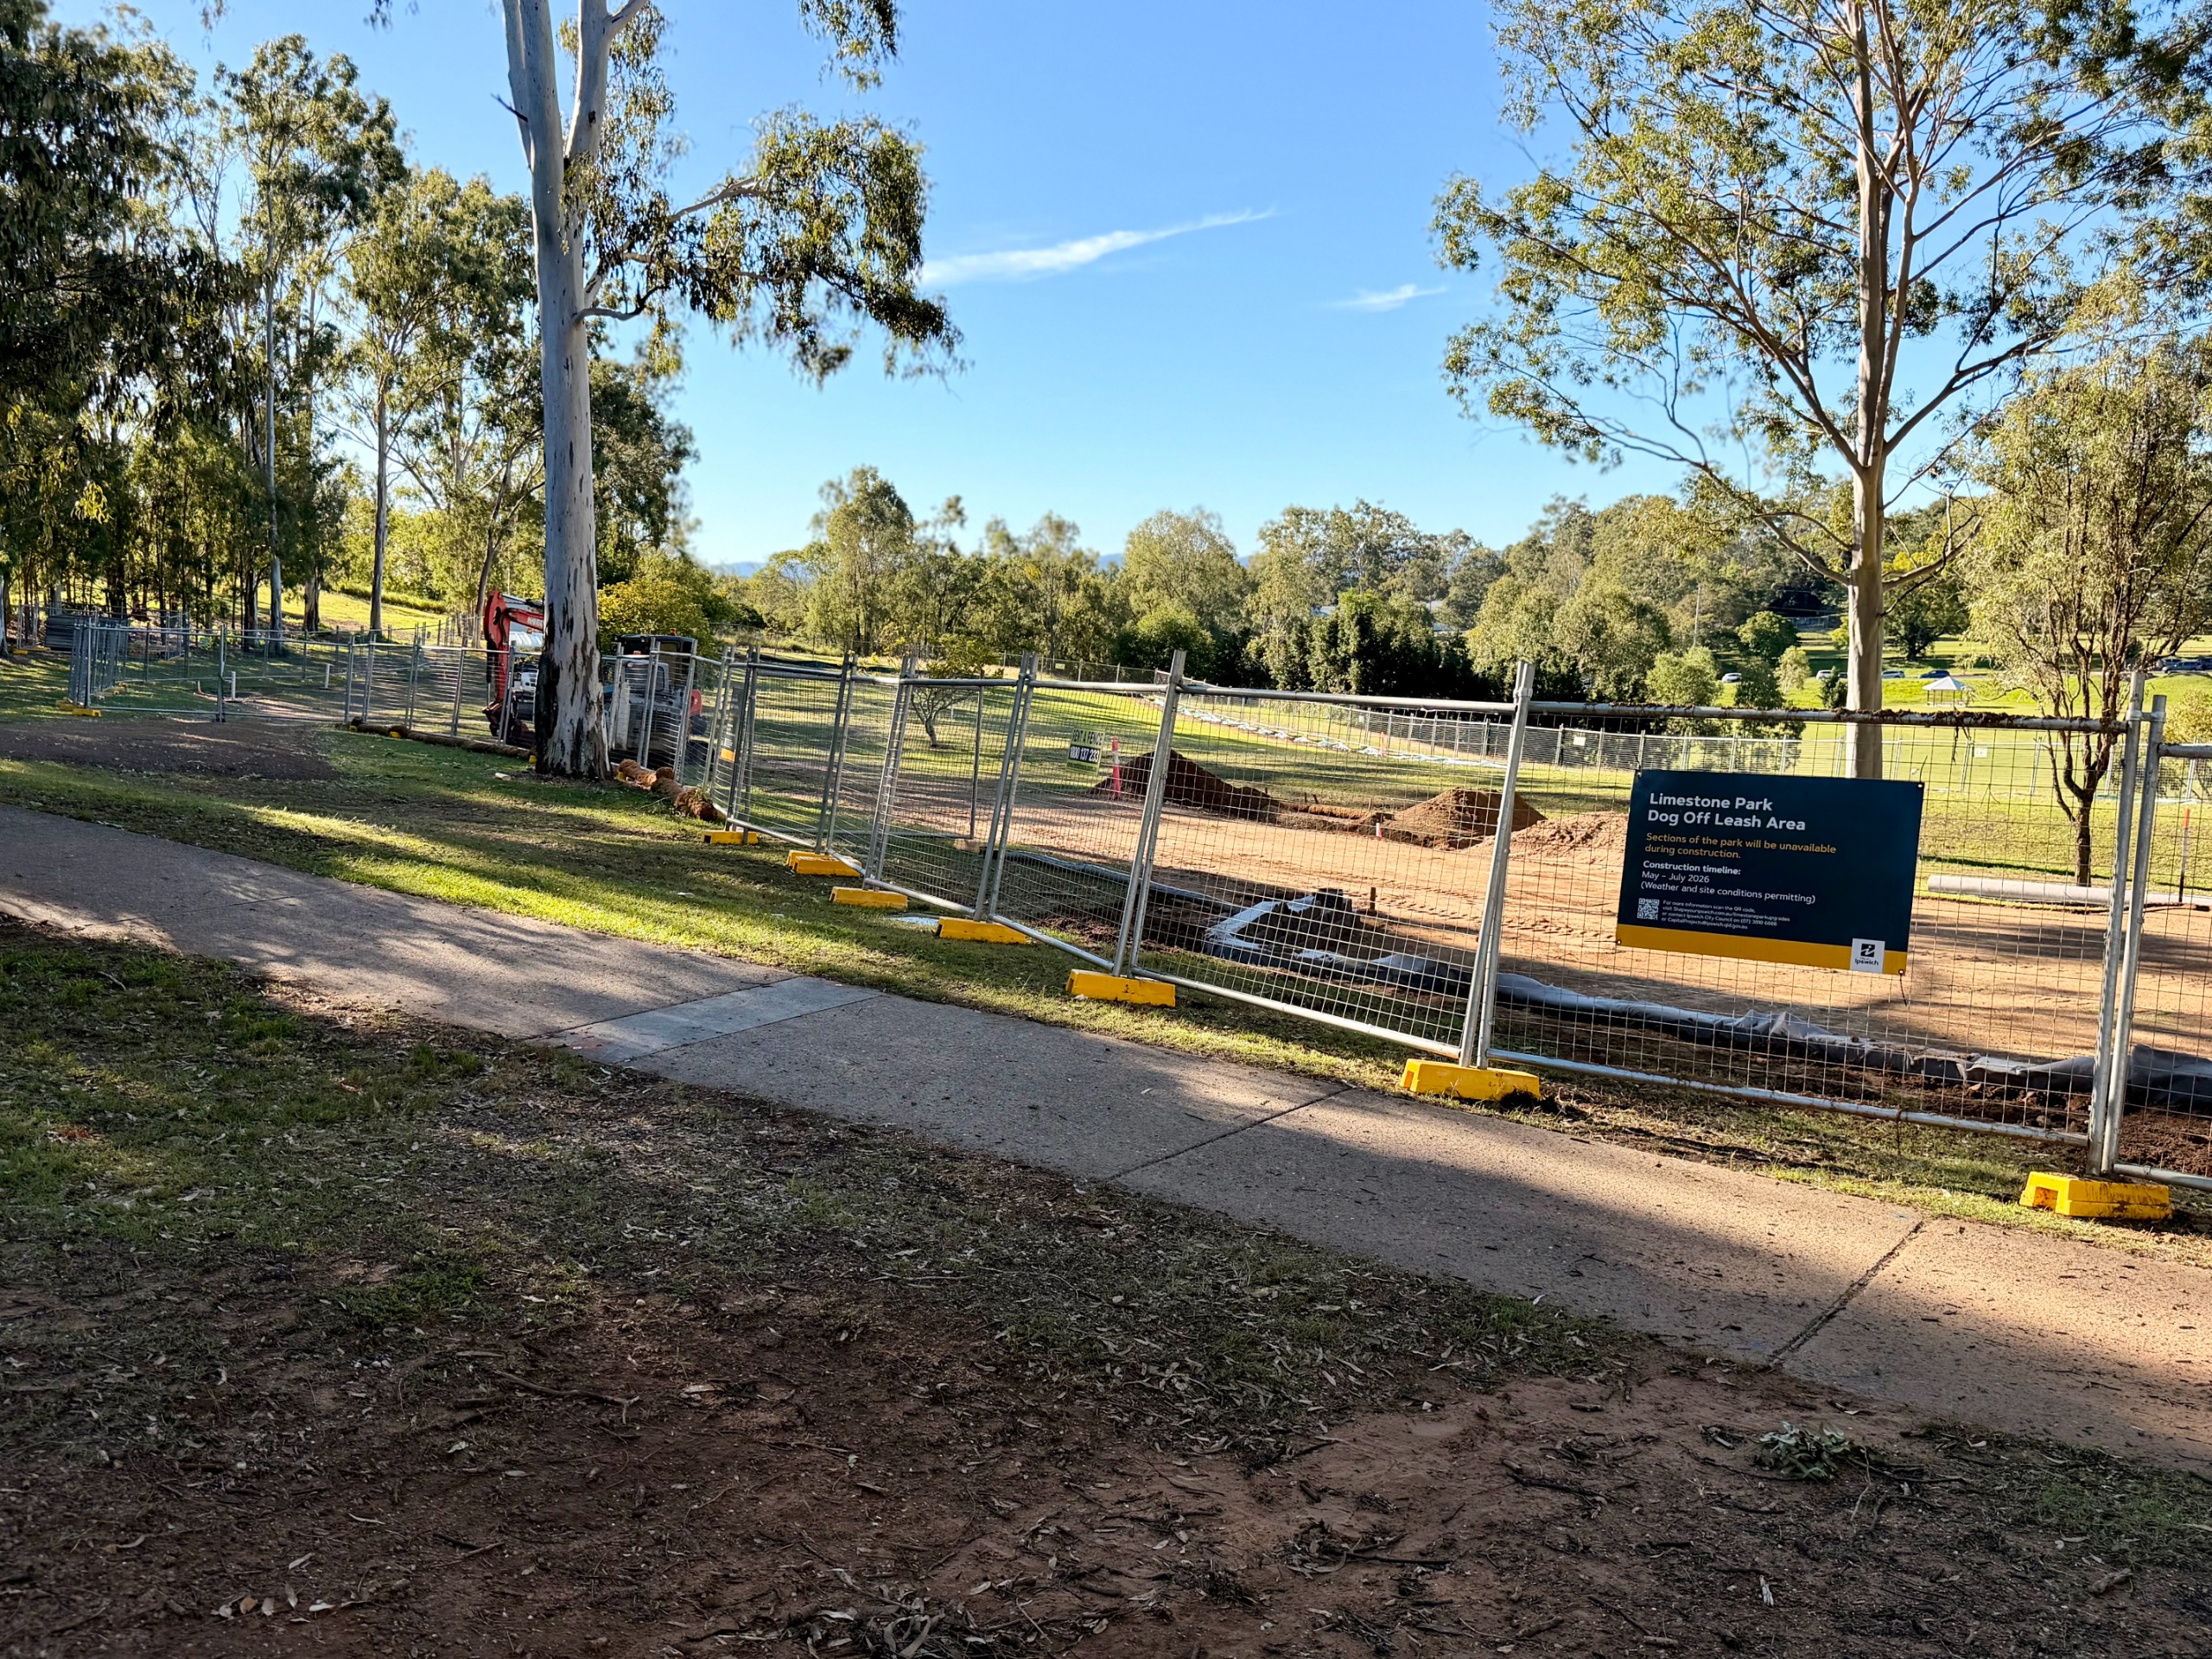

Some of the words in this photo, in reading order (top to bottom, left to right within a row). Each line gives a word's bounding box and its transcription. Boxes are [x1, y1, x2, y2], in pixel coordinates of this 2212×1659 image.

[1088, 731, 1103, 746] FENCE
[1080, 747, 1089, 760] 137
[1089, 748, 1100, 763] 233
[1649, 792, 1731, 809] Limestone
[1734, 797, 1774, 811] Park
[1648, 809, 1680, 826] Dog
[1683, 810, 1712, 824] Off
[1714, 813, 1762, 828] Leash
[1766, 817, 1806, 830] Area
[1646, 832, 1687, 843] Sections
[1688, 836, 1700, 844] of
[1702, 836, 1719, 845] the
[1720, 838, 1743, 848] park
[1745, 839, 1761, 849] will
[1764, 840, 1777, 849] be
[1779, 842, 1837, 854] unavailable
[1644, 844, 1675, 856] during
[1677, 848, 1741, 859] construction.
[1643, 860, 1700, 872] Construction
[1702, 865, 1742, 874] timeline:
[1642, 871, 1660, 880] May
[1669, 873, 1687, 883] July
[1688, 874, 1710, 883] 2026
[1640, 881, 1680, 892] (Weather
[1681, 885, 1698, 893] and
[1699, 886, 1715, 894] site
[1717, 888, 1763, 899] conditions
[1764, 893, 1816, 905] permitting)
